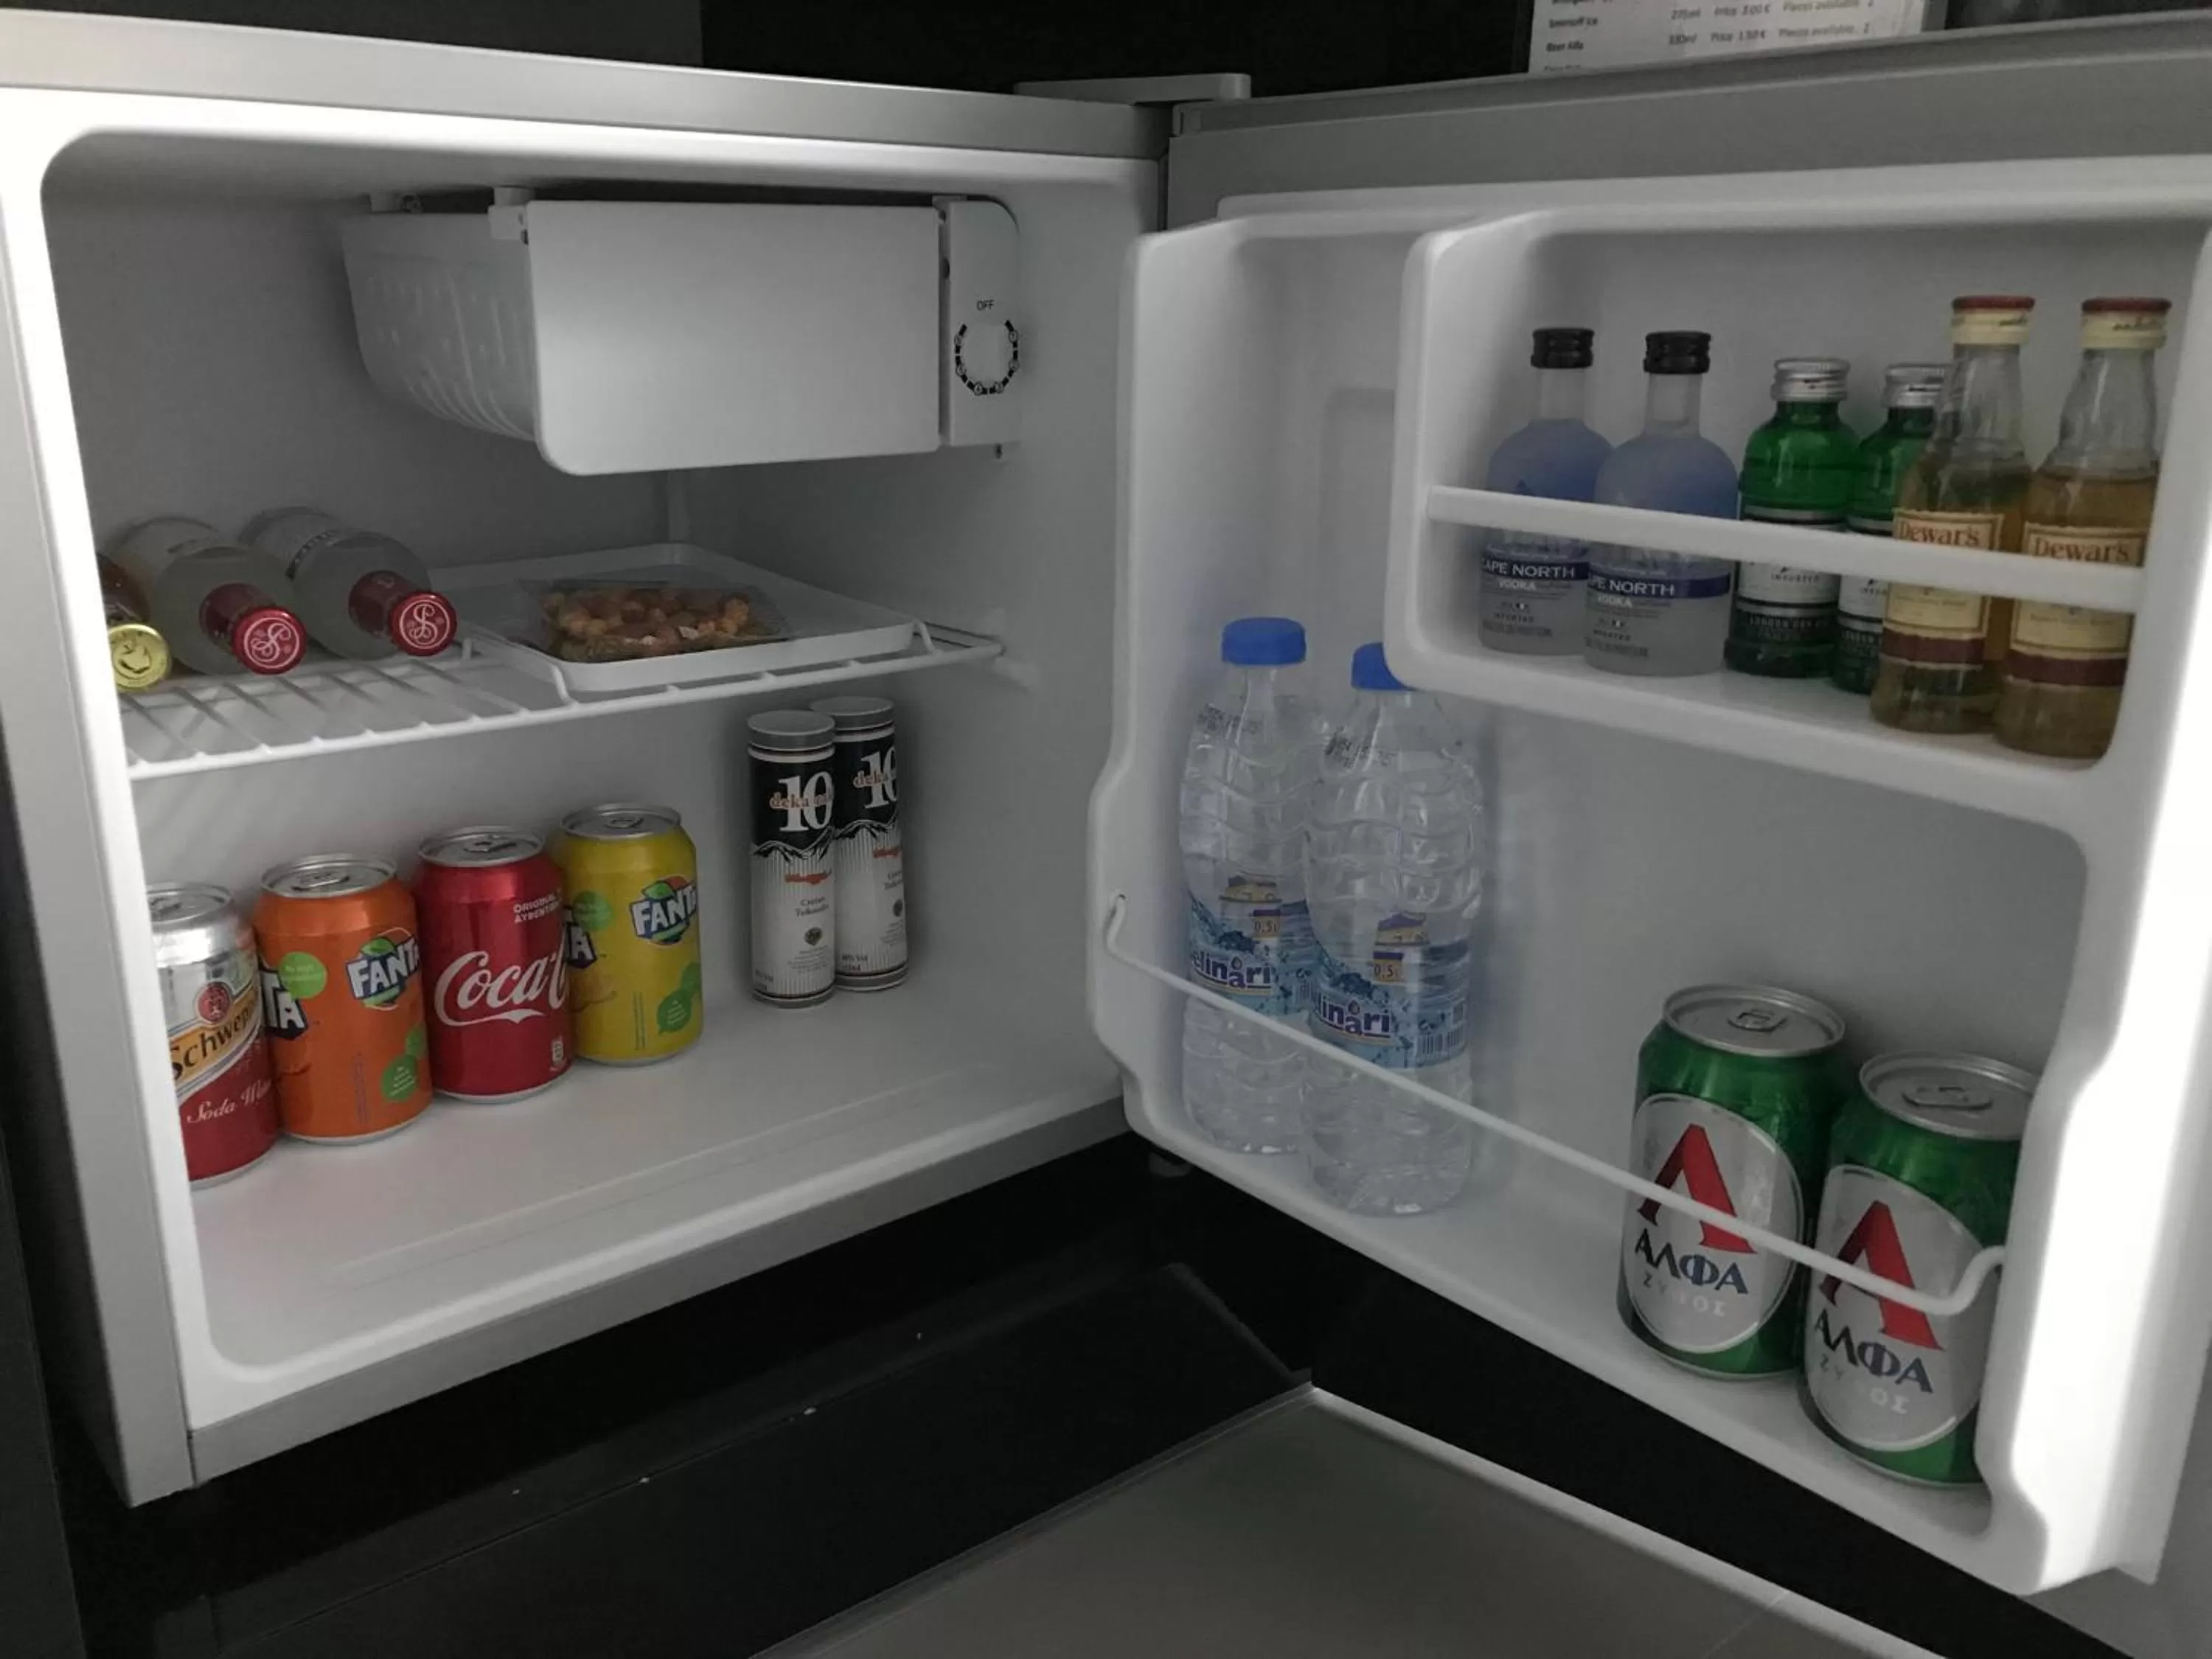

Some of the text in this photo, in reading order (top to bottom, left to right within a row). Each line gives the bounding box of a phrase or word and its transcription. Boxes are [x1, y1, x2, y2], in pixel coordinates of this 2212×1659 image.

[976, 299, 995, 310] OFF
[1512, 563, 1575, 578] NORTH
[1499, 577, 1537, 591] VODKA
[1593, 575, 1675, 597] PE NORTH
[779, 771, 834, 832] 10
[187, 1097, 235, 1124] Soda
[1635, 1228, 1748, 1295] ΑΛΦΑ
[1815, 1310, 1934, 1394] ΑΛΦΑ
